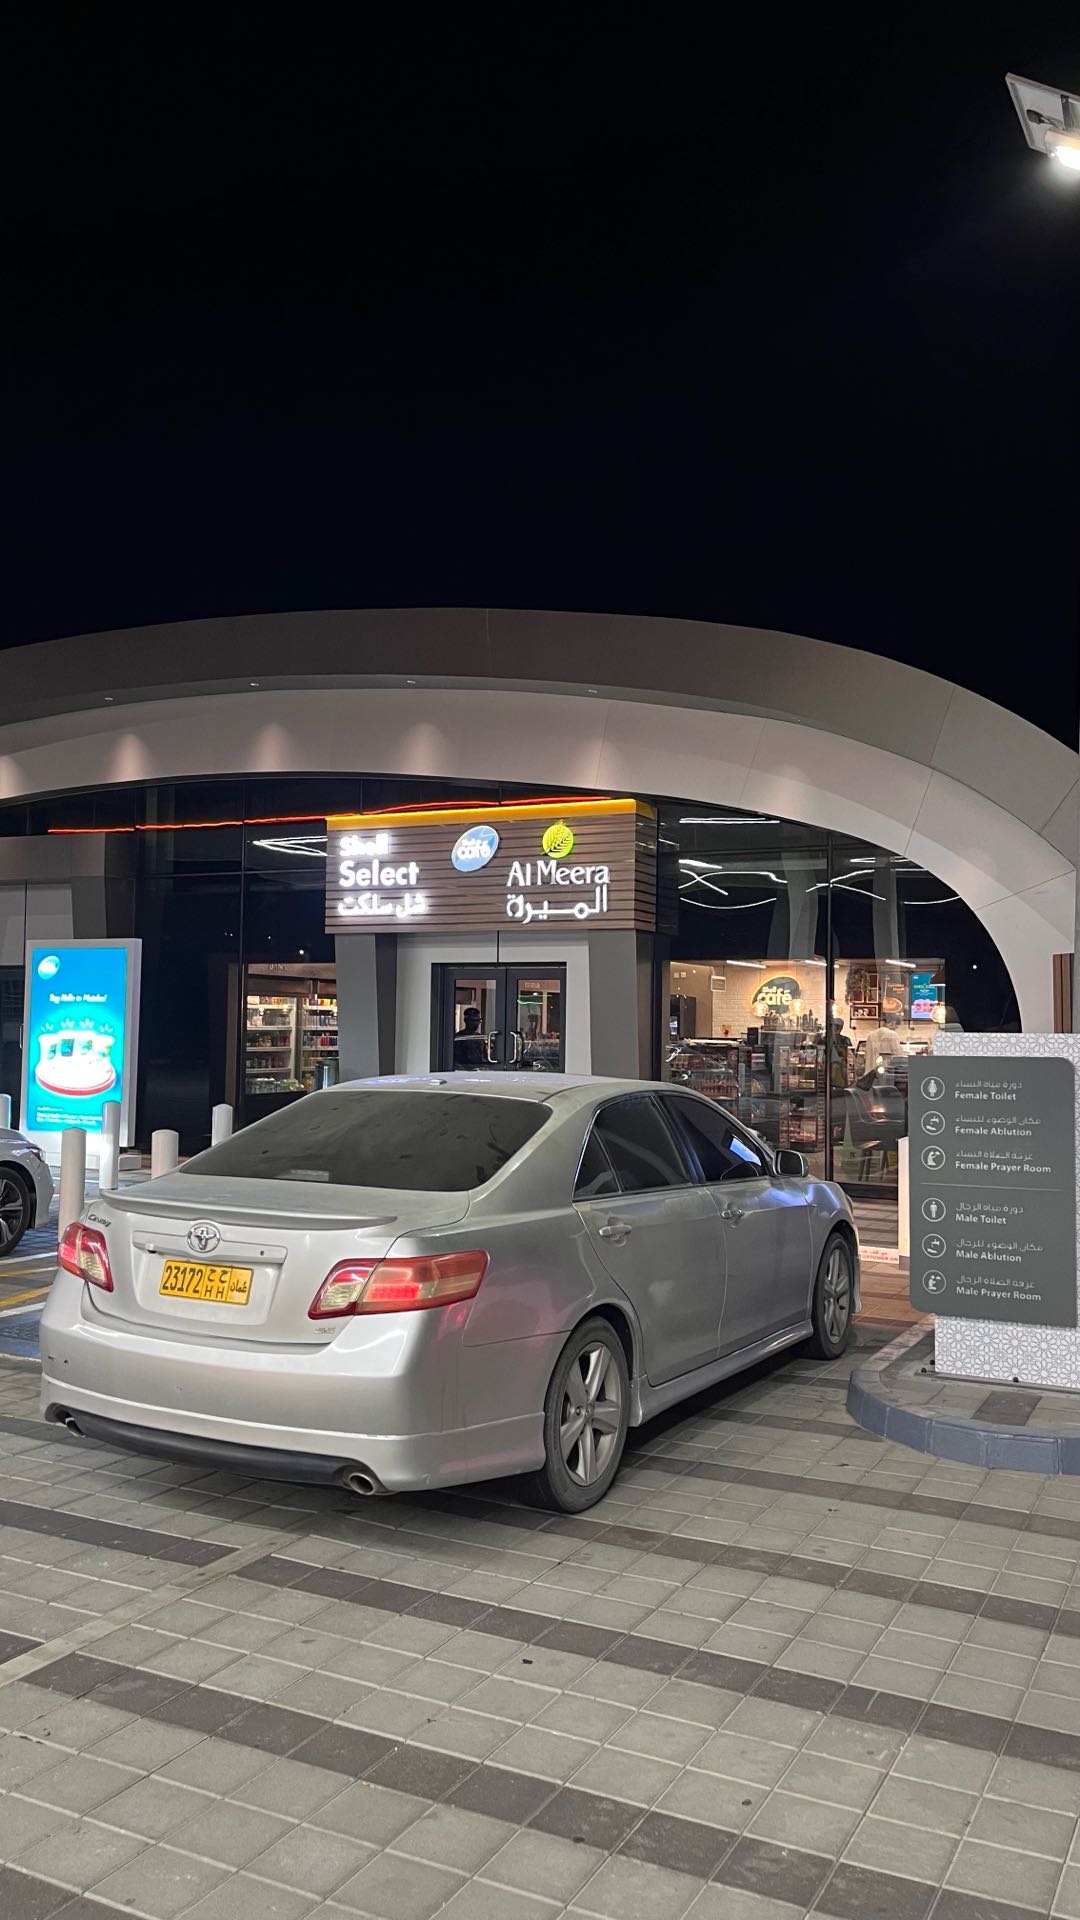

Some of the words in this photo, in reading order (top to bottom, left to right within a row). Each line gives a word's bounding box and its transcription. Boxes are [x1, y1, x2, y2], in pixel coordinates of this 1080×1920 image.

[339, 832, 389, 857] Shell
[338, 858, 420, 888] Select
[506, 861, 532, 887] Al
[536, 859, 611, 885] Meera
[506, 883, 608, 925] الميرة
[954, 1090, 989, 1100] Female
[990, 1091, 1017, 1101] Toilet
[954, 1125, 989, 1135] Female
[990, 1127, 1032, 1137] Ablution
[955, 1160, 989, 1170] Female
[990, 1162, 1021, 1173] Prayer
[1023, 1164, 1052, 1173] Room
[955, 1213, 979, 1223] Male
[980, 1214, 1007, 1225] Toilet
[956, 1249, 979, 1259] Male
[980, 1251, 1022, 1262] Ablution
[162, 1265, 204, 1294] 23172
[956, 1286, 979, 1296] Male
[981, 1288, 1012, 1300] Prayer
[1013, 1291, 1042, 1301] Room
